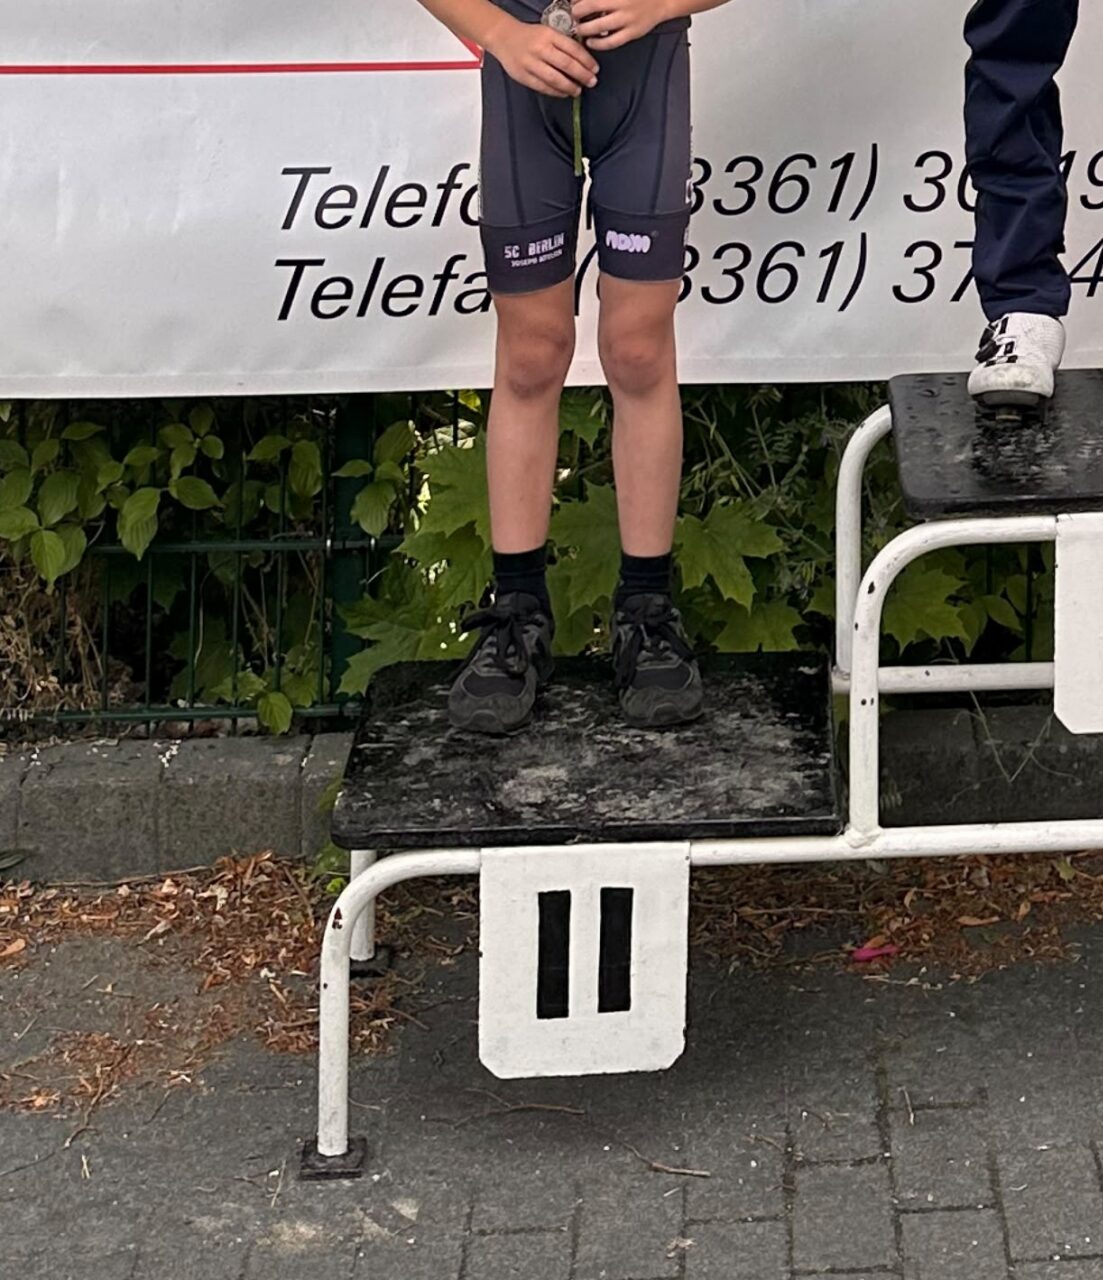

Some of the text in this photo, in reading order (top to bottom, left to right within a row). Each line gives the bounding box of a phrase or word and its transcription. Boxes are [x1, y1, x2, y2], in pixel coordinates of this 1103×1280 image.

[504, 232, 565, 259] SC BERLIN
[274, 254, 492, 320] Telefa
[536, 886, 634, 1020] II
